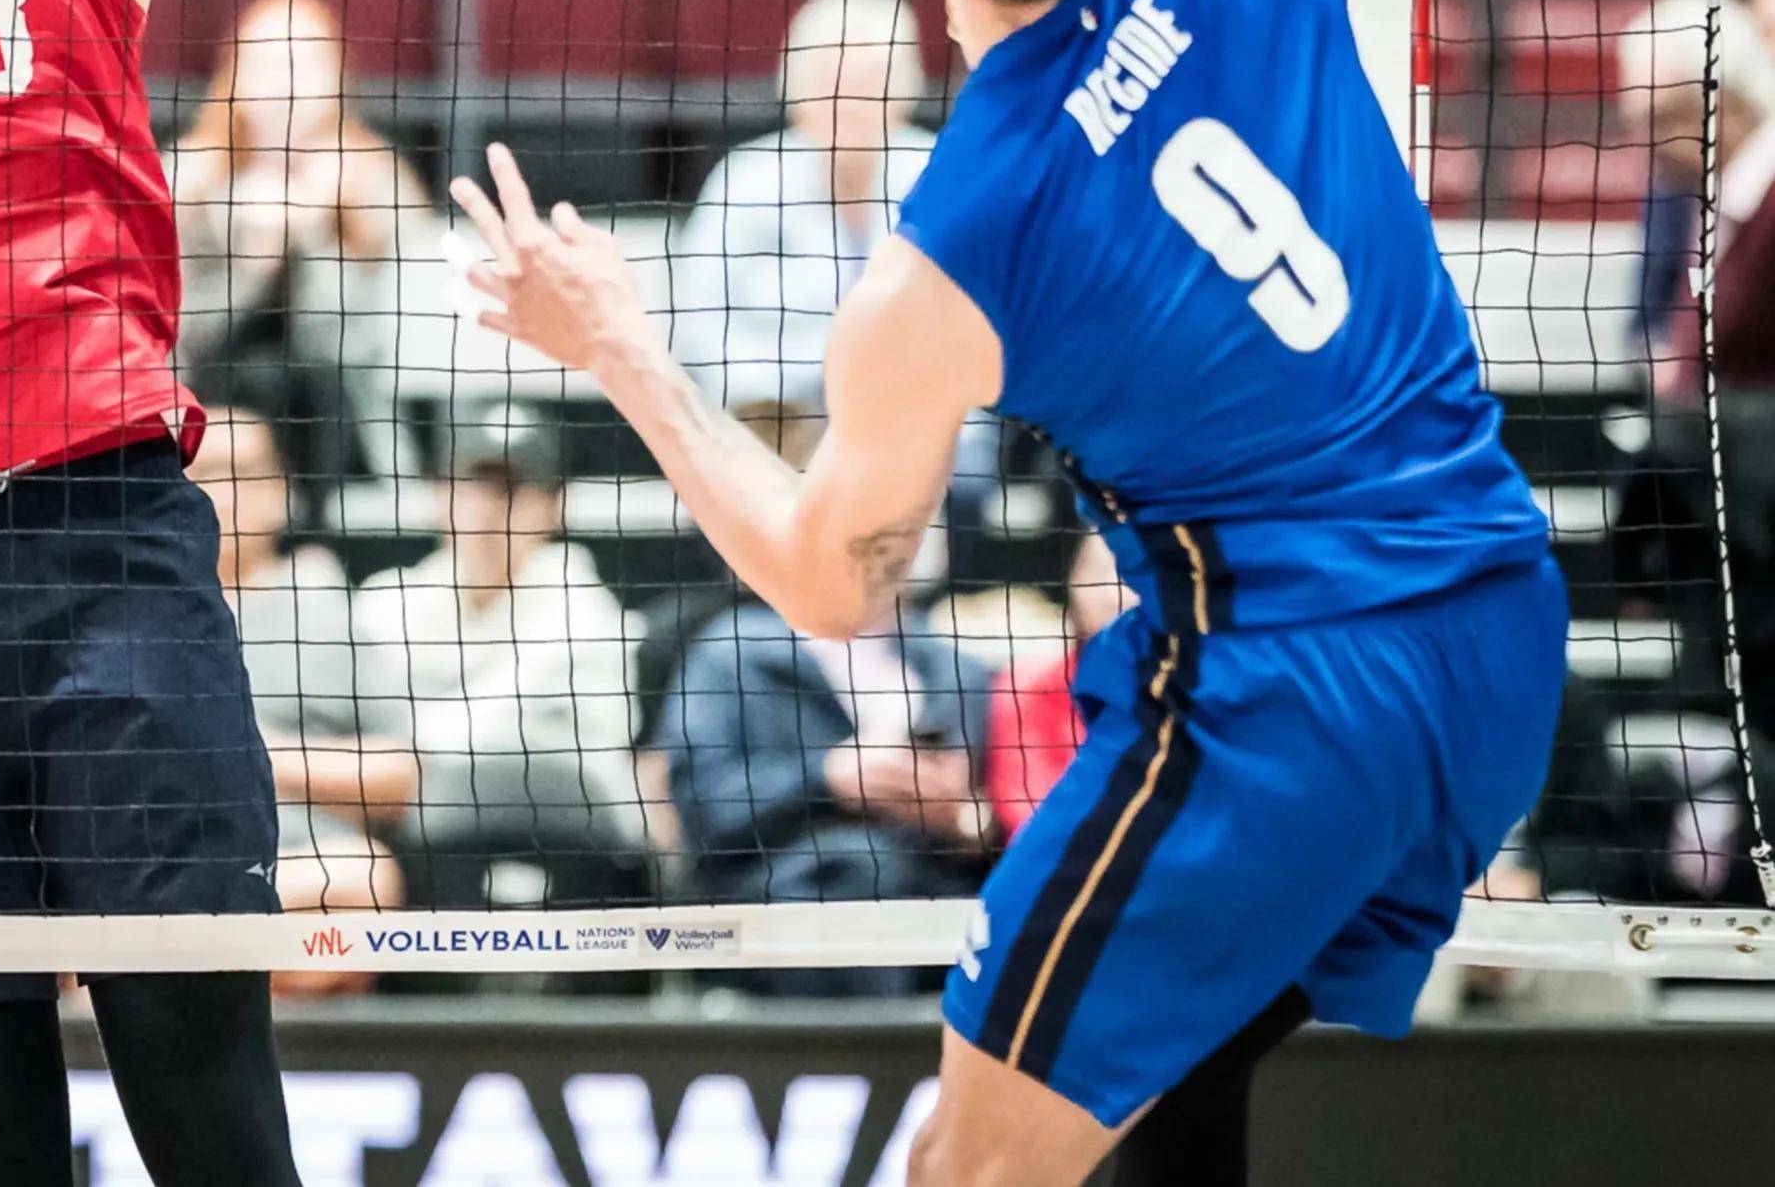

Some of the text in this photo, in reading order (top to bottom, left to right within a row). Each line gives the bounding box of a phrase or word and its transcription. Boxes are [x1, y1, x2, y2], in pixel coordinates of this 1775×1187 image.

[1151, 116, 1350, 354] 9
[576, 927, 635, 938] NATIONS
[675, 929, 734, 940] Volleyball
[303, 927, 569, 956] VNL VOLLEYBALL
[576, 940, 628, 950] LEAGUE
